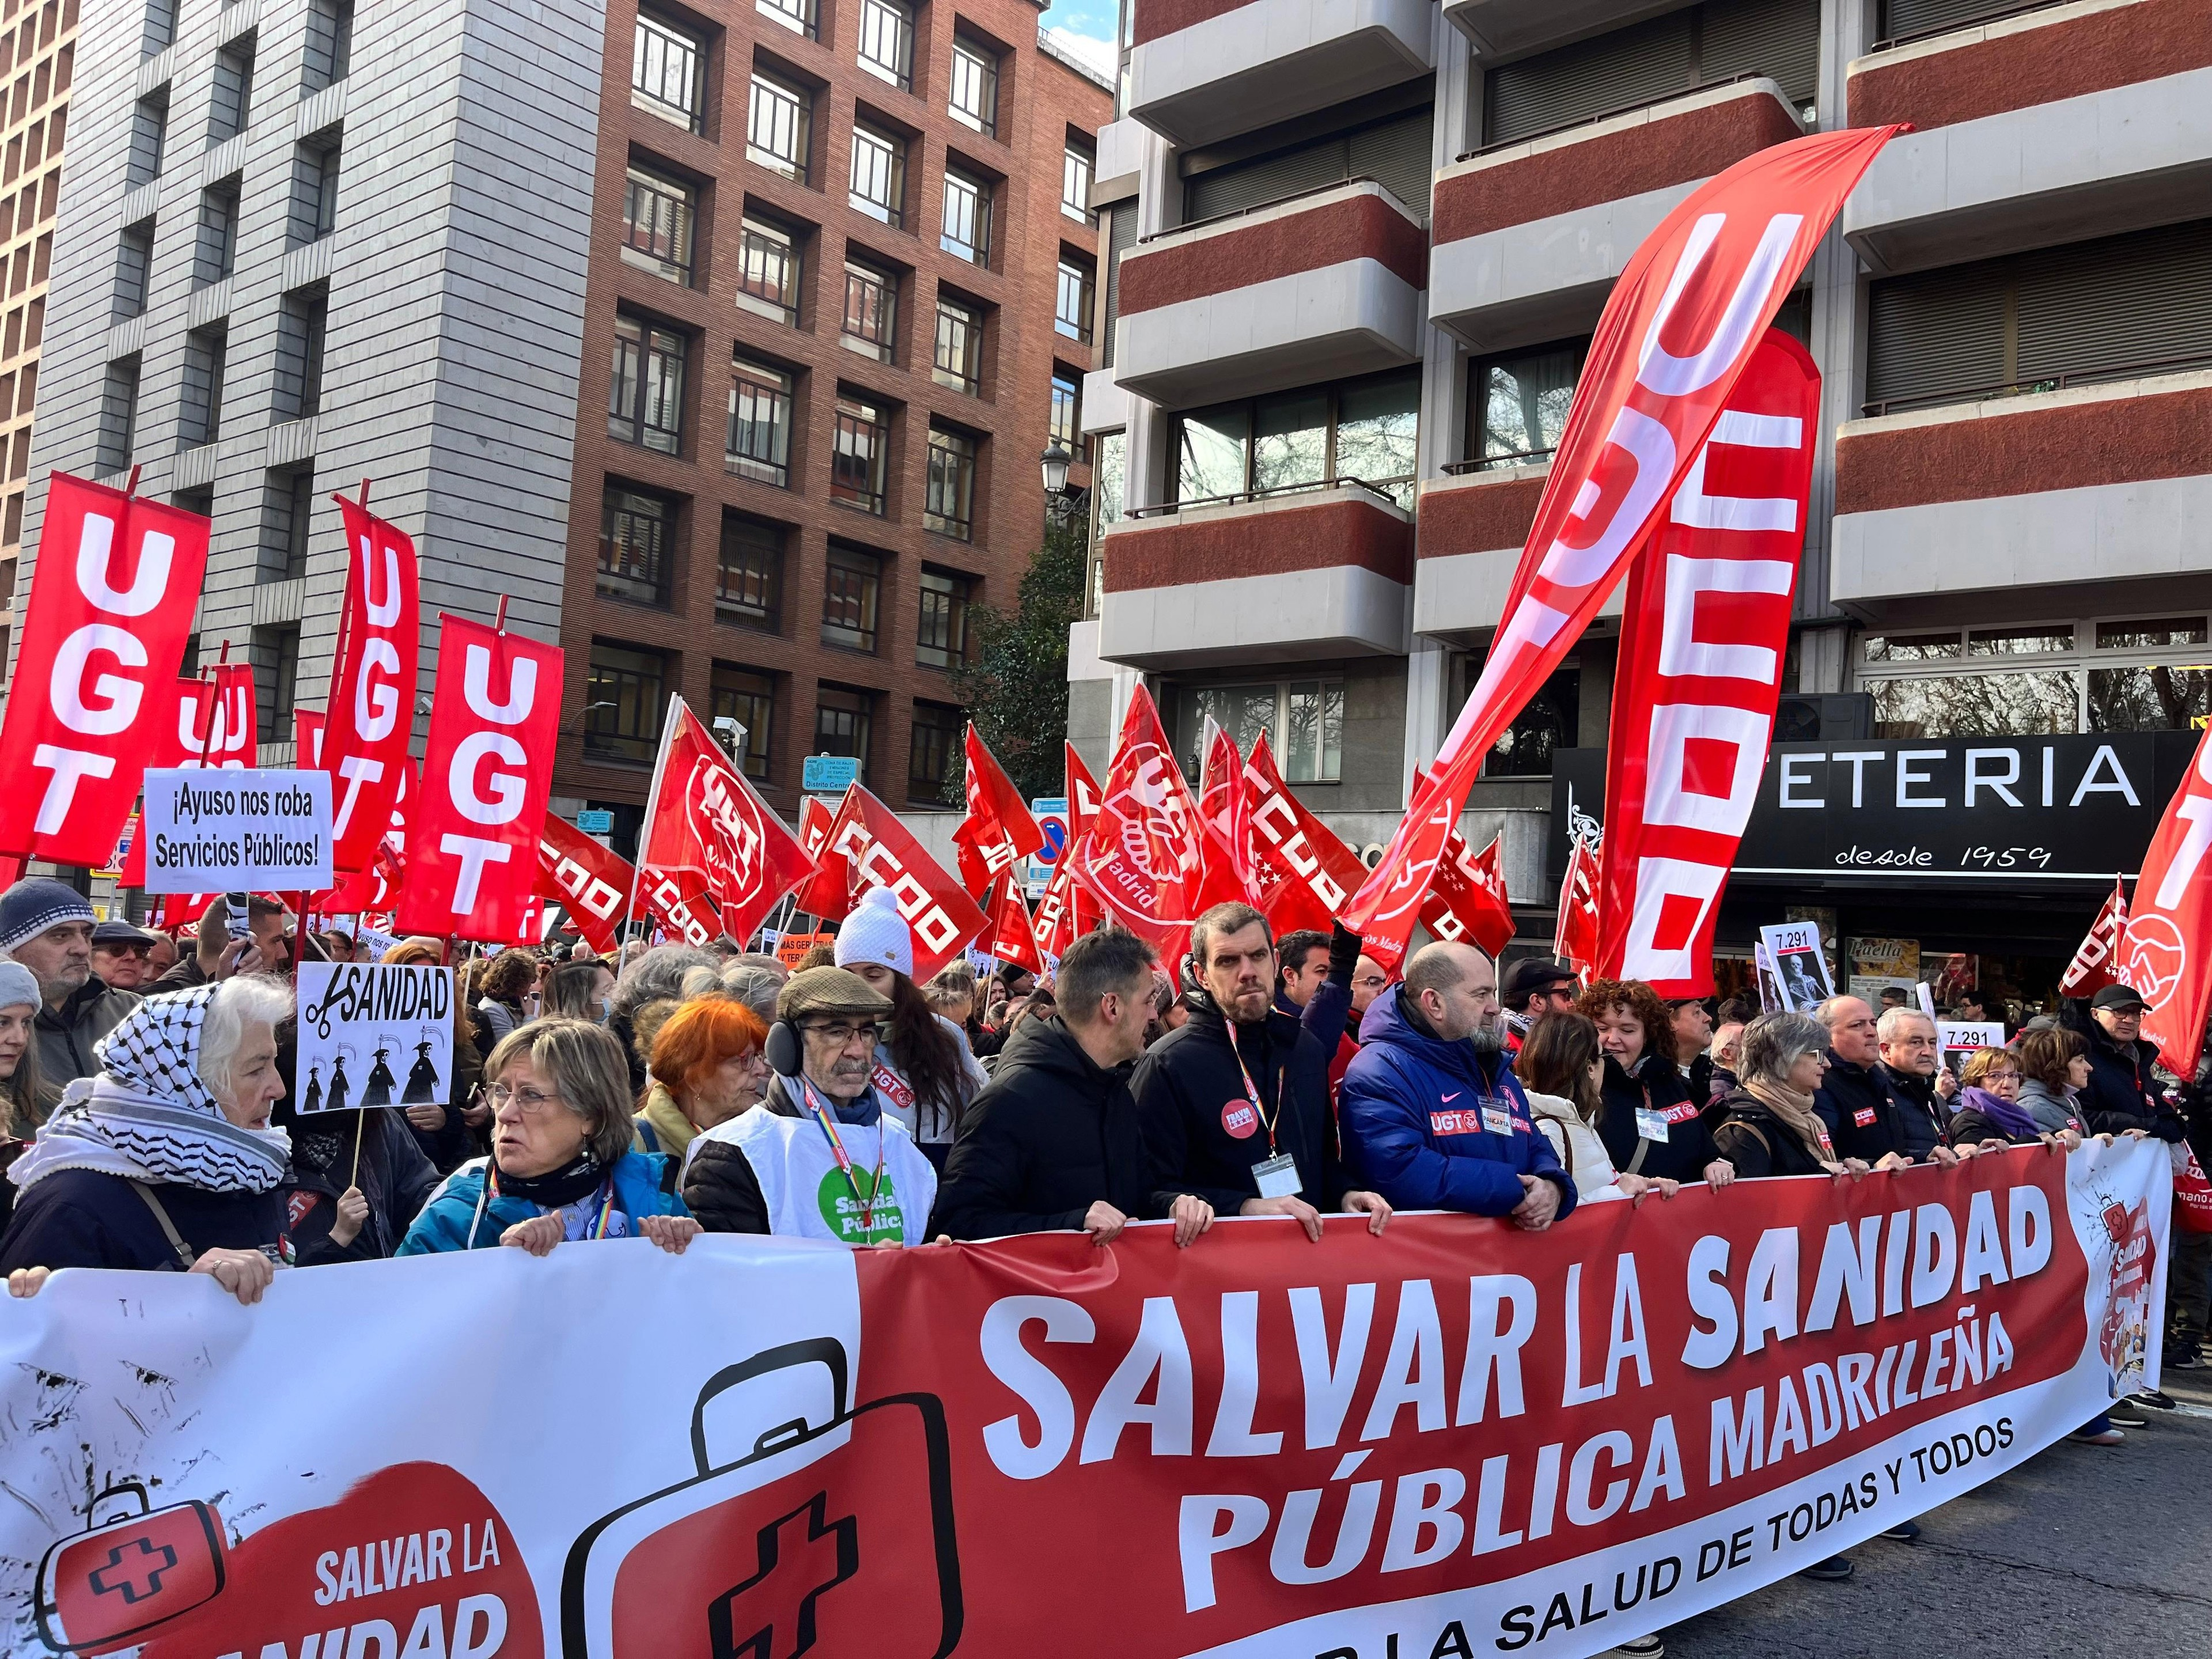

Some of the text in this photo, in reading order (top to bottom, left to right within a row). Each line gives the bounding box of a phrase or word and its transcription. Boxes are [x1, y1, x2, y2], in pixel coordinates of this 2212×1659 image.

[1434, 213, 1804, 768] UGT
[32, 512, 176, 835] UGT
[333, 534, 402, 840] UGT
[1620, 409, 1802, 982] CCOO
[174, 782, 313, 825] ¡Ayuso nos roba
[440, 643, 537, 914] UGT
[1766, 745, 2141, 808] ETERIA
[155, 833, 319, 869] Servicios Públicos!
[1835, 846, 2051, 868] desde 1959
[1377, 935, 1404, 955] Madri
[1776, 930, 1808, 949] 7.291
[1849, 941, 1902, 957] Paella
[340, 967, 449, 1022] SANIDAD
[1947, 1031, 1987, 1046] 7.291
[1431, 1113, 1462, 1131] UGT
[1483, 1115, 1510, 1128] PANCARTA
[980, 1184, 2052, 1480] SALVAR LA SANIDAD
[1178, 1304, 2014, 1613] PÚBLICA MADRILEÑA
[315, 1518, 500, 1606] SALVAR LA
[1495, 1556, 1681, 1652] SALUD
[1696, 1525, 1755, 1584] DE
[1767, 1471, 1878, 1552] TODAS
[1884, 1457, 1905, 1496] Y
[1910, 1417, 2014, 1484] TODOS
